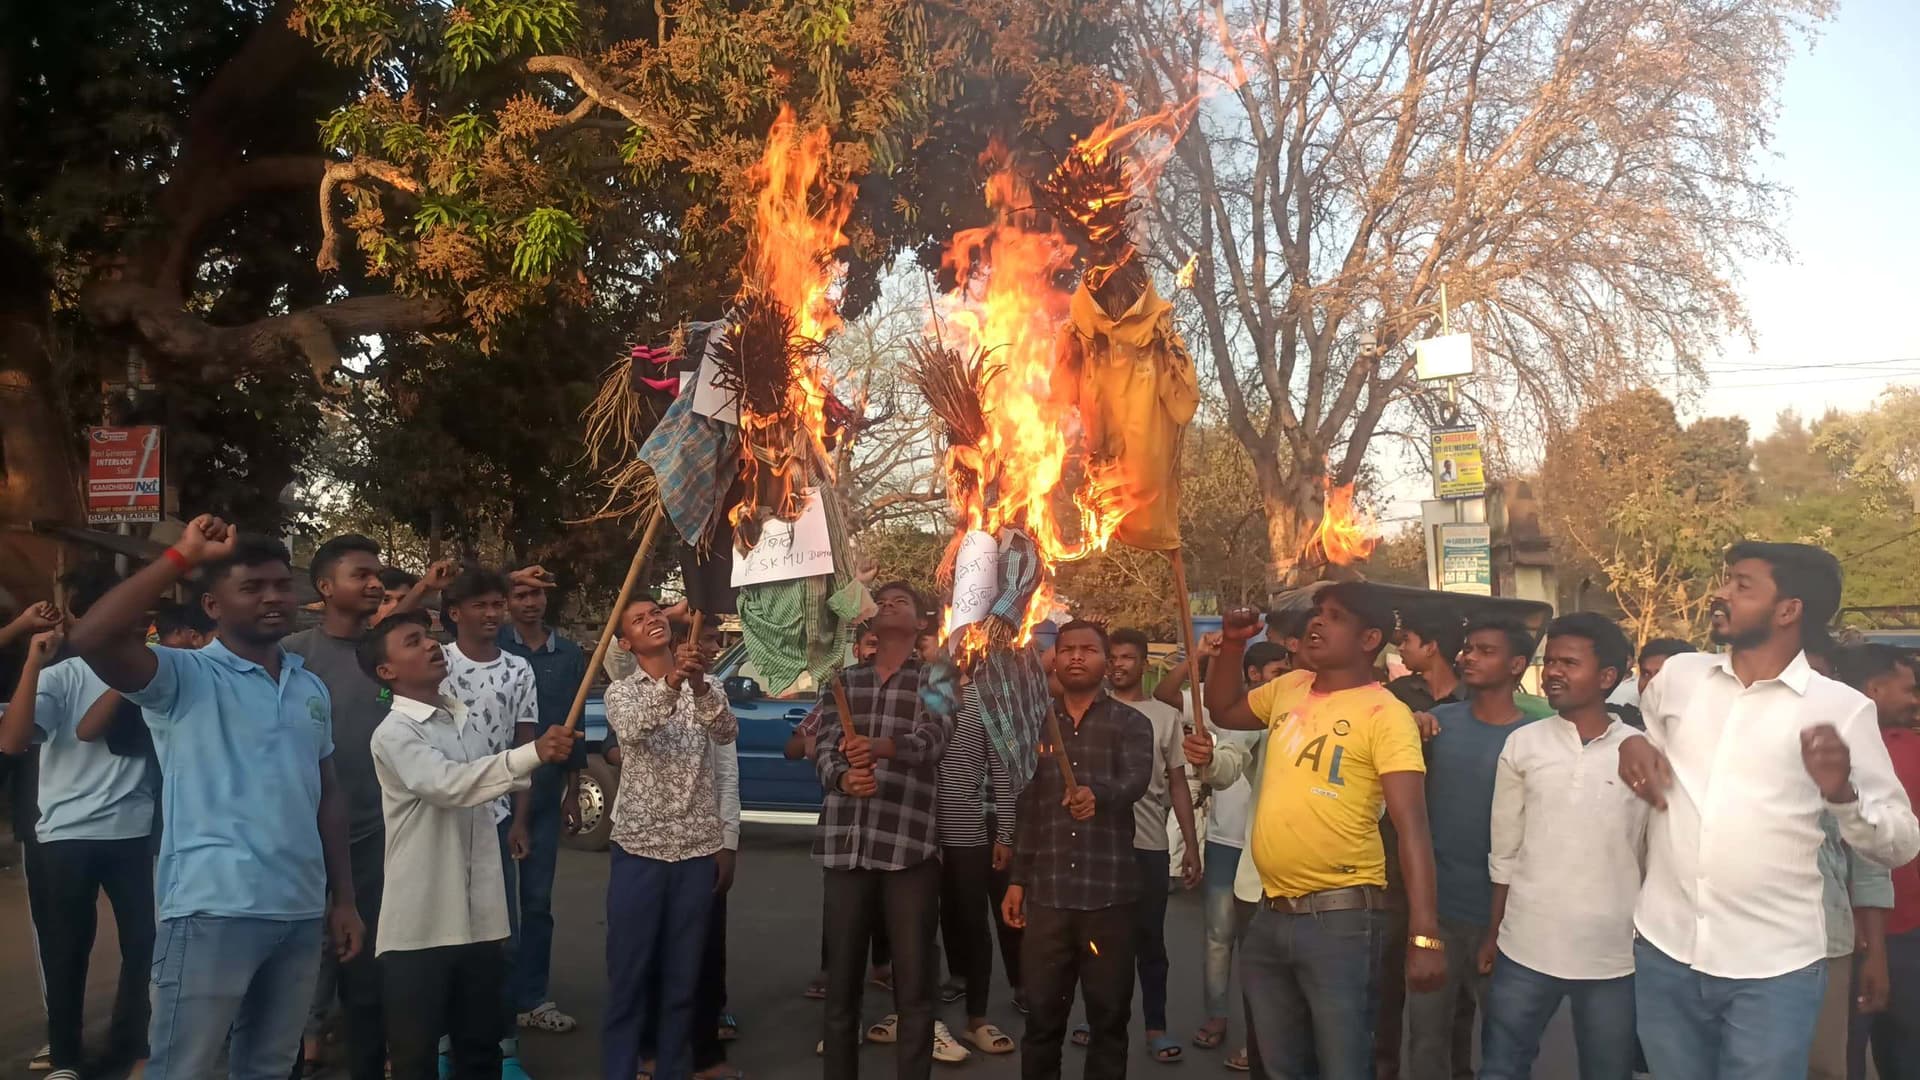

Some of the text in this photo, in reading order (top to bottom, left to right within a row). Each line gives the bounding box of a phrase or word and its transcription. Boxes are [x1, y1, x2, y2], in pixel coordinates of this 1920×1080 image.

[96, 458, 134, 466] INTERLOCK
[92, 483, 134, 491] KAMDHENU
[119, 512, 158, 520] TRADERS
